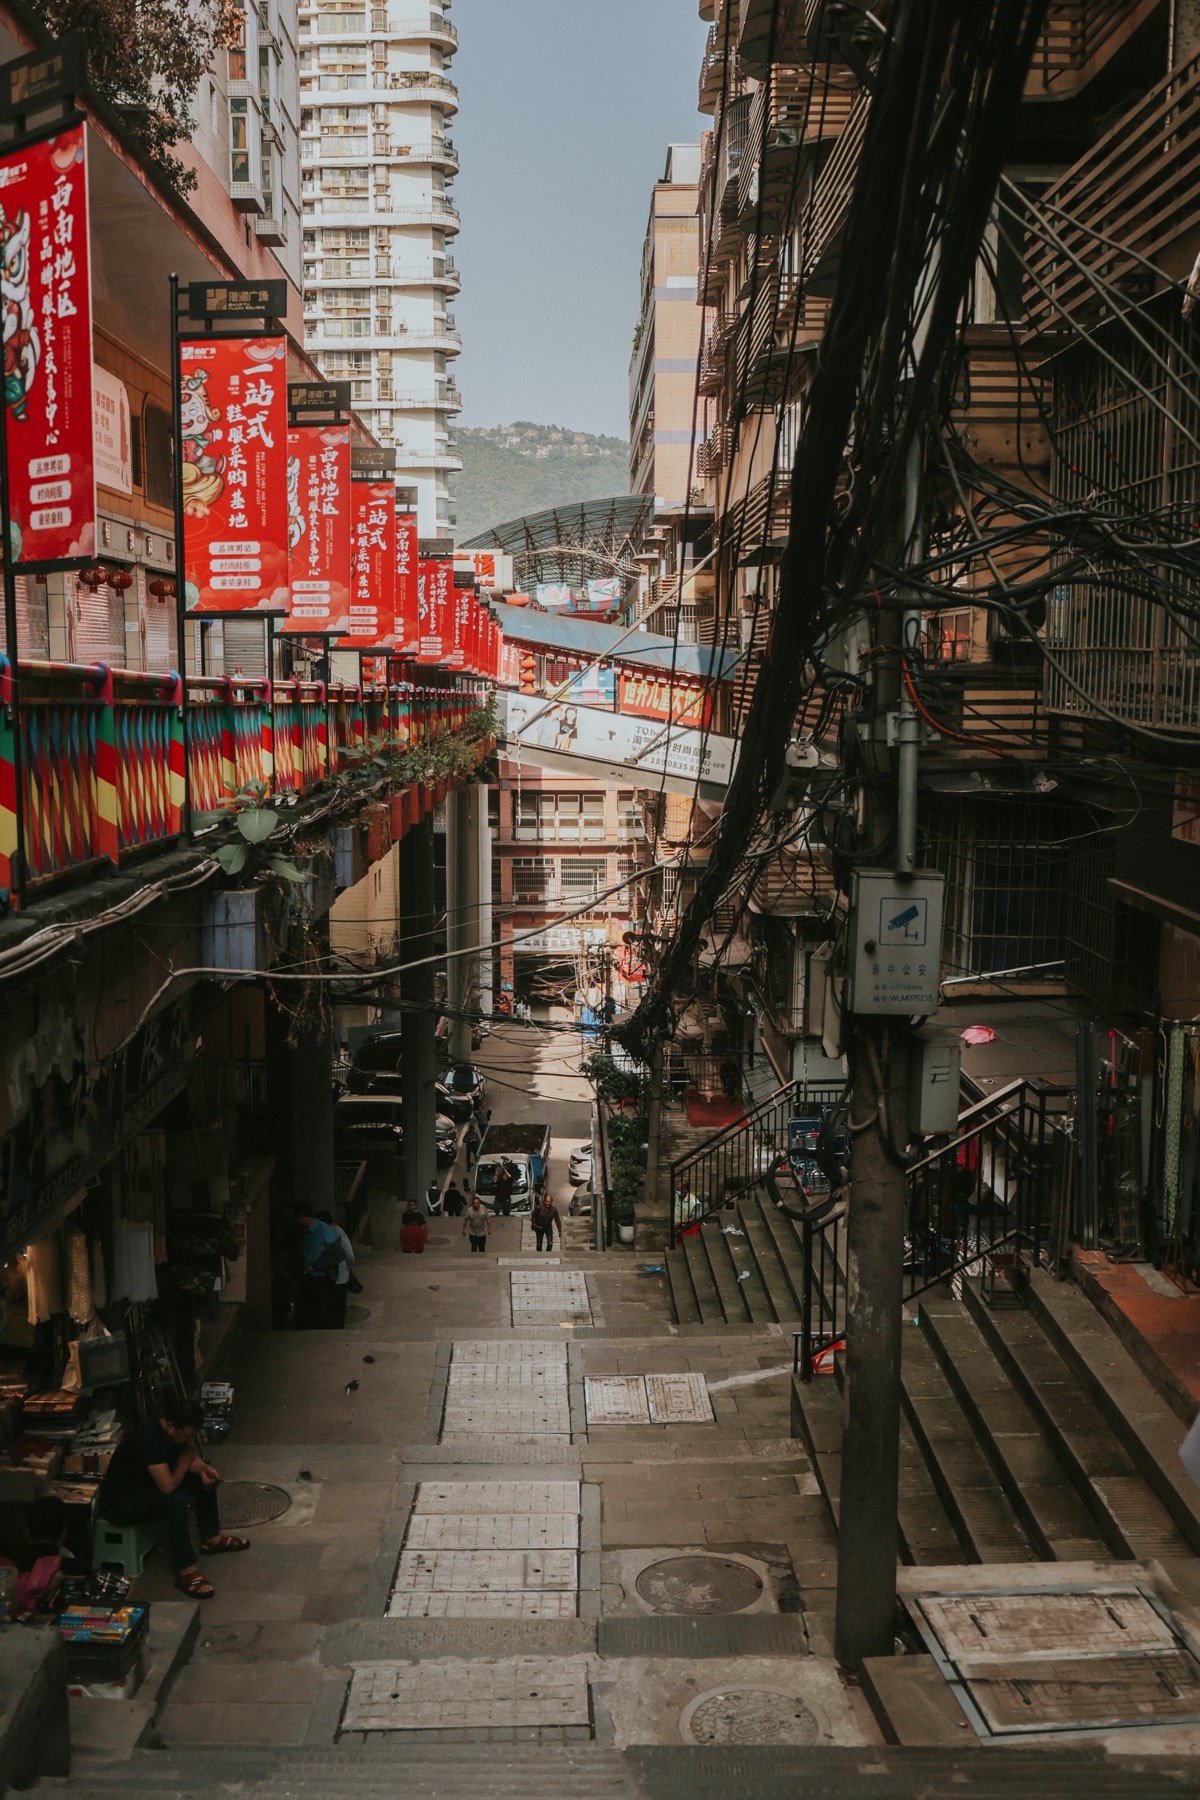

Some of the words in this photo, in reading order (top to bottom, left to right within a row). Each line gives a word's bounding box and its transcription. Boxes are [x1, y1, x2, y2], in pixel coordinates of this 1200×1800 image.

[51, 175, 77, 319] 西南地区
[242, 363, 274, 448] 一站式
[226, 403, 249, 528] 鞋服采购基地
[320, 446, 339, 515] 西南地区
[367, 499, 388, 550] 一站式
[218, 545, 251, 553] 品牌男装
[219, 562, 251, 570] 时尚鞋服
[396, 528, 410, 574] 西南地区
[220, 578, 251, 587] 童装童鞋
[668, 760, 687, 771] 0835
[871, 963, 927, 976] 渝中公安
